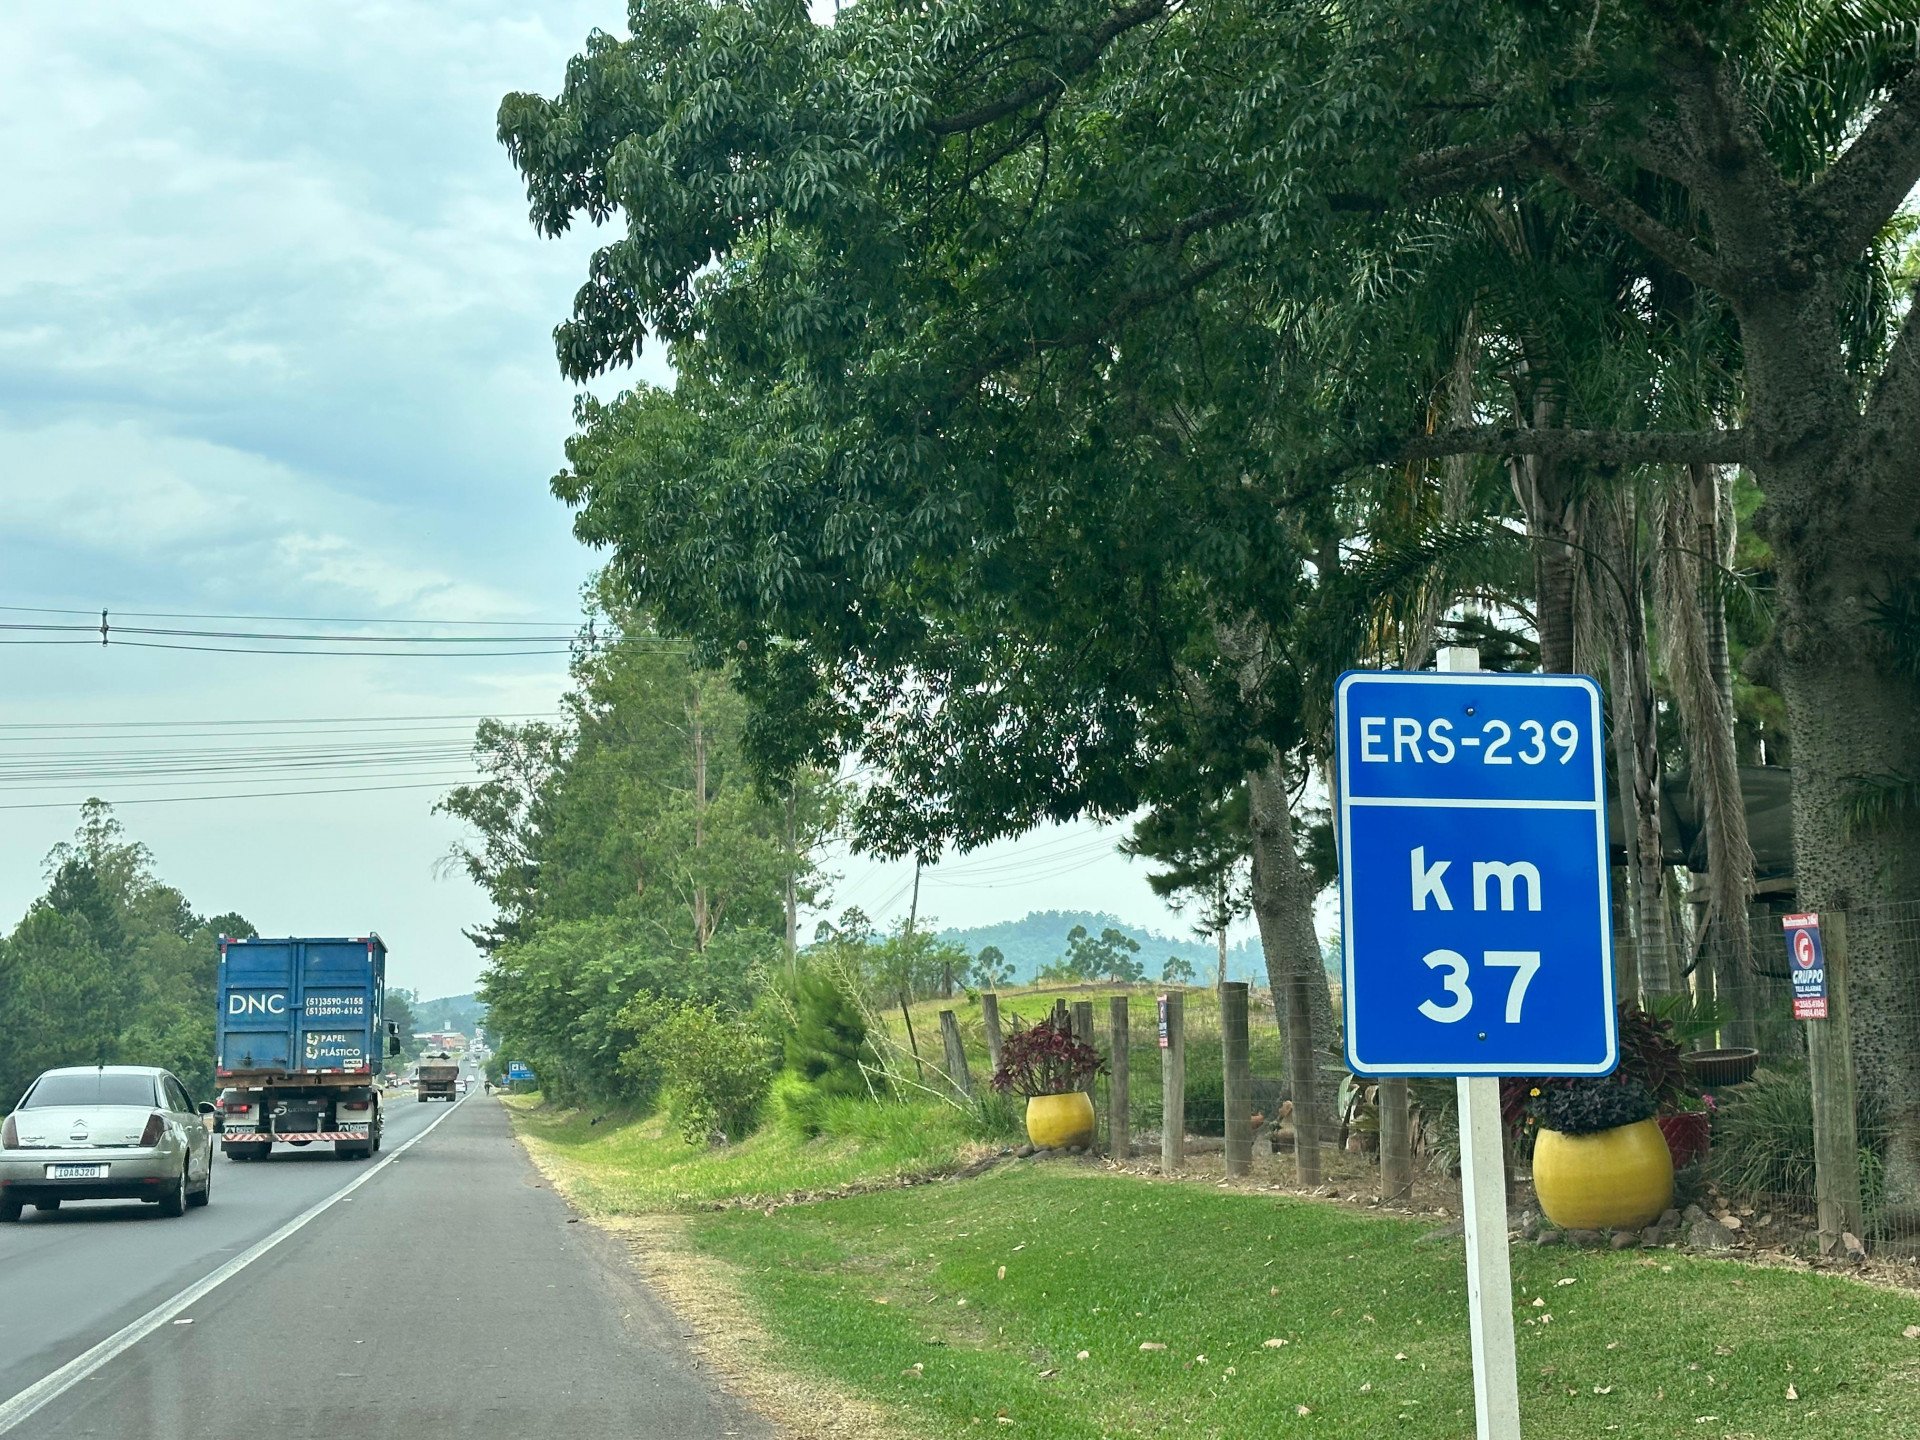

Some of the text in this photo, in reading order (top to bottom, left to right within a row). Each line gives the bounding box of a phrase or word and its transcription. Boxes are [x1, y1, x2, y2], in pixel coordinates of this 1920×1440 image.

[1360, 716, 1580, 765] ERS-239
[1410, 845, 1542, 912] km
[1799, 937, 1809, 962] G
[1417, 948, 1541, 1024] 37
[1792, 969, 1824, 984] GRUPPO
[228, 993, 285, 1015] DNC
[305, 997, 364, 1007] (51)3590-4155
[320, 1034, 346, 1043] PAPEL
[320, 1047, 361, 1057] PLÁSTICO
